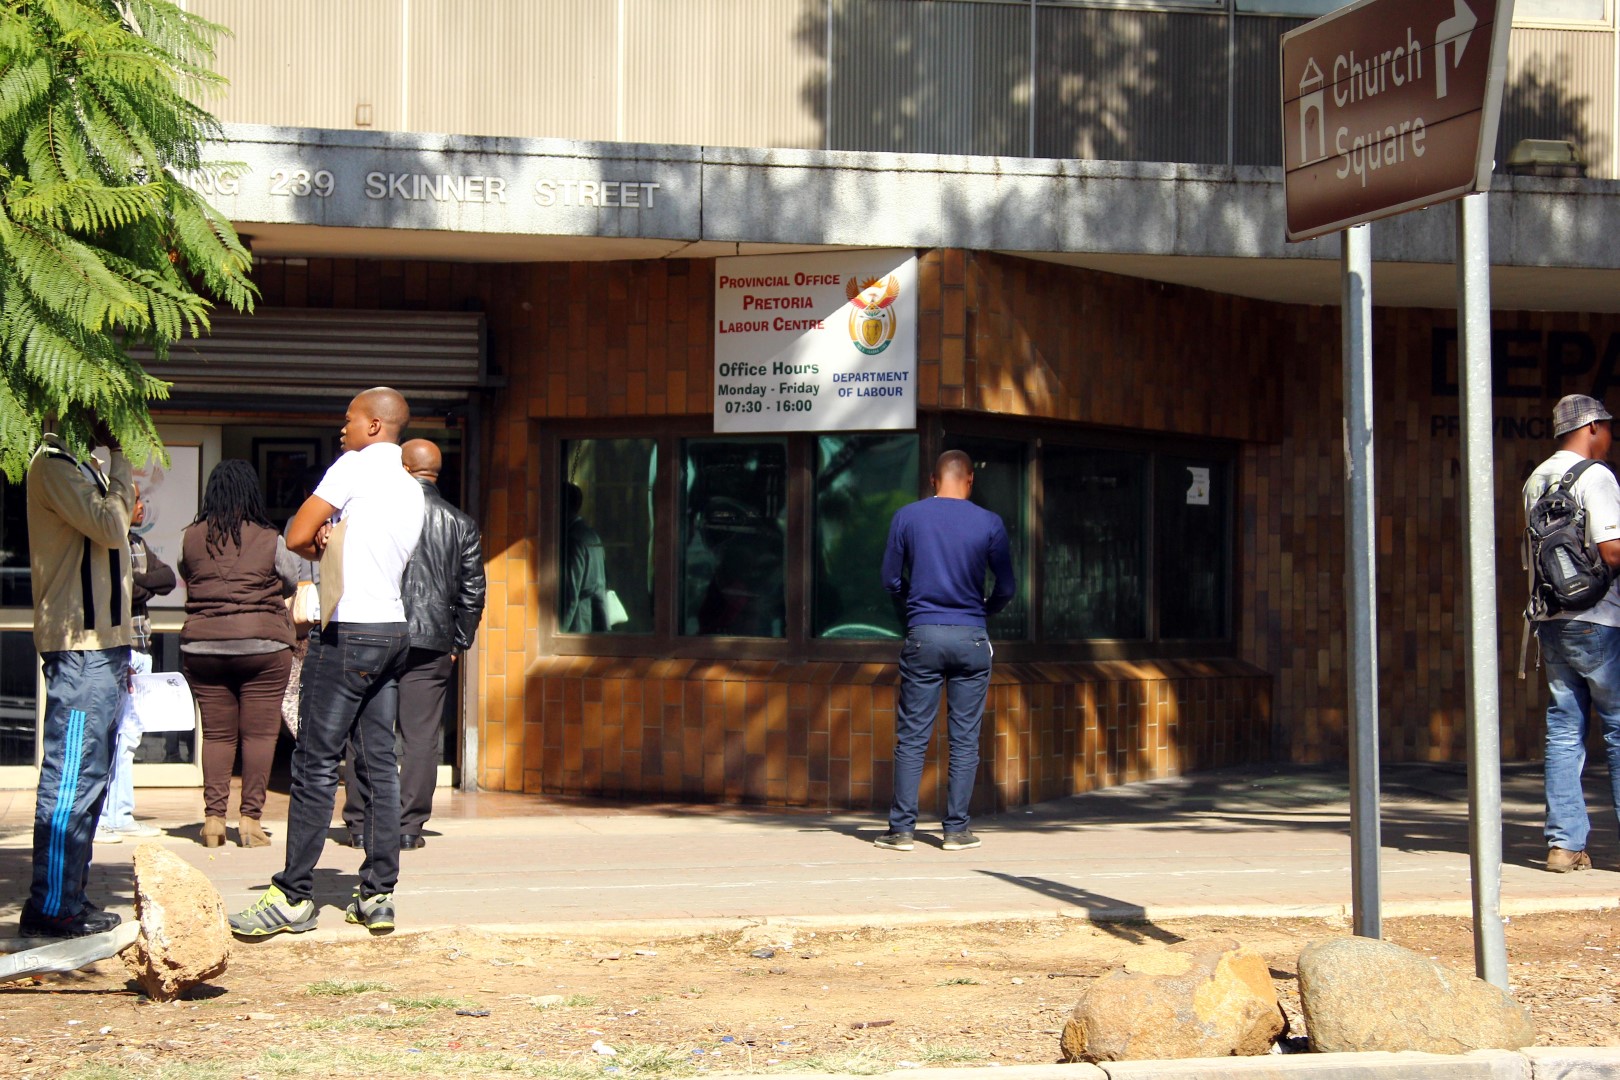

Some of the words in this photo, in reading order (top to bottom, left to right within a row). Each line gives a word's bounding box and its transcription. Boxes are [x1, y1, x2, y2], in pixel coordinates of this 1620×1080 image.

[1333, 27, 1422, 108] Church
[1335, 116, 1426, 188] Square
[270, 168, 335, 198] 239
[364, 171, 507, 204] SKINNER
[534, 177, 661, 209] STREET
[719, 275, 790, 289] PROVINCIAL
[794, 272, 841, 286] OFFICE
[743, 295, 814, 311] PRETORIA
[719, 319, 769, 334] LABOUR
[772, 317, 825, 331] CENTRE
[718, 362, 767, 377] Office
[772, 361, 820, 375] Hours
[832, 371, 910, 383] DEPARTMENT
[718, 383, 767, 398] Monday
[779, 382, 820, 396] Friday
[838, 387, 853, 398] OF
[857, 386, 903, 397] LABOUR
[725, 400, 762, 414] 07:30
[776, 399, 812, 412] 16:00
